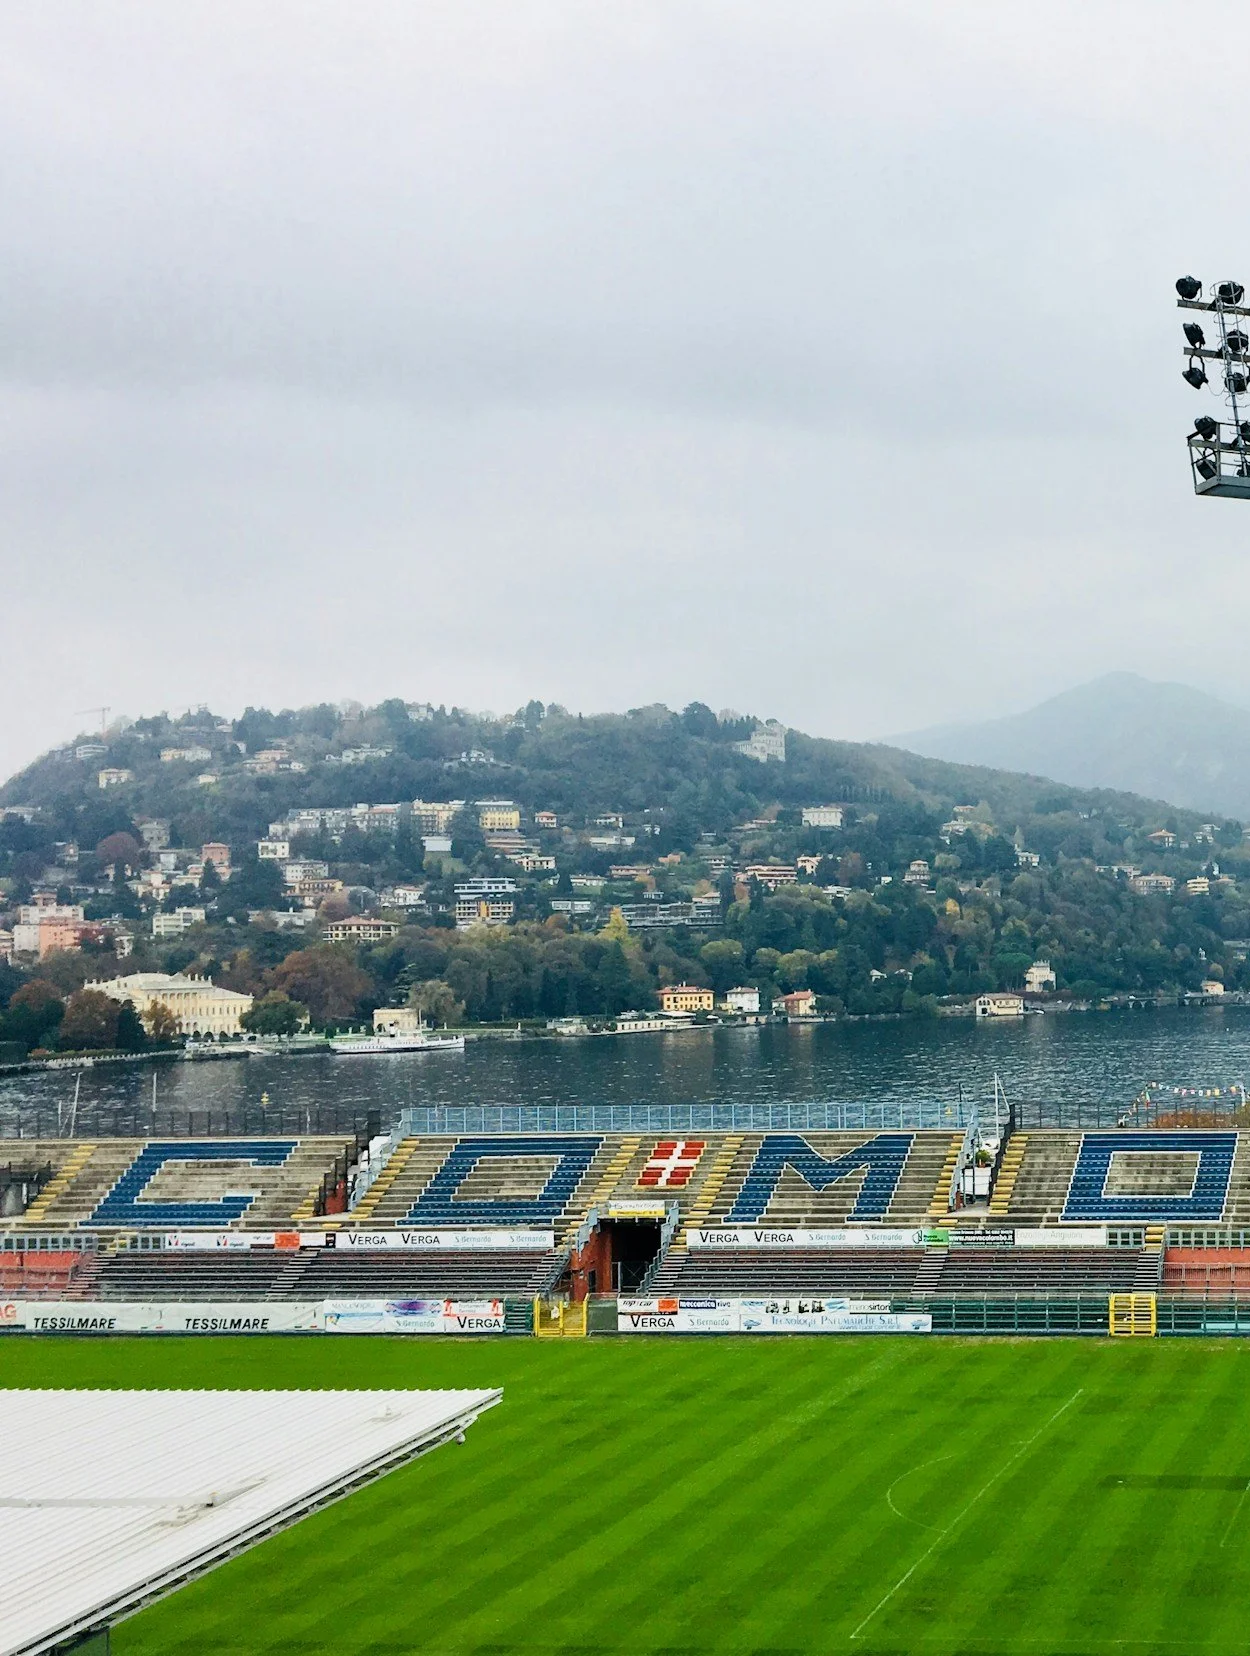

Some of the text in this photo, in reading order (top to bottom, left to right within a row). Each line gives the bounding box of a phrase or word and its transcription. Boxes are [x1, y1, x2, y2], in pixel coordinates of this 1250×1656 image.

[348, 1233, 388, 1245] VERGA
[401, 1233, 441, 1245] VERGA
[699, 1231, 740, 1243] VERGA
[754, 1231, 794, 1243] VERGA
[33, 1317, 117, 1329] TESSILMARE
[185, 1318, 270, 1330] TESSILMARE
[457, 1316, 501, 1329] VERGA
[630, 1315, 676, 1328] VERGA
